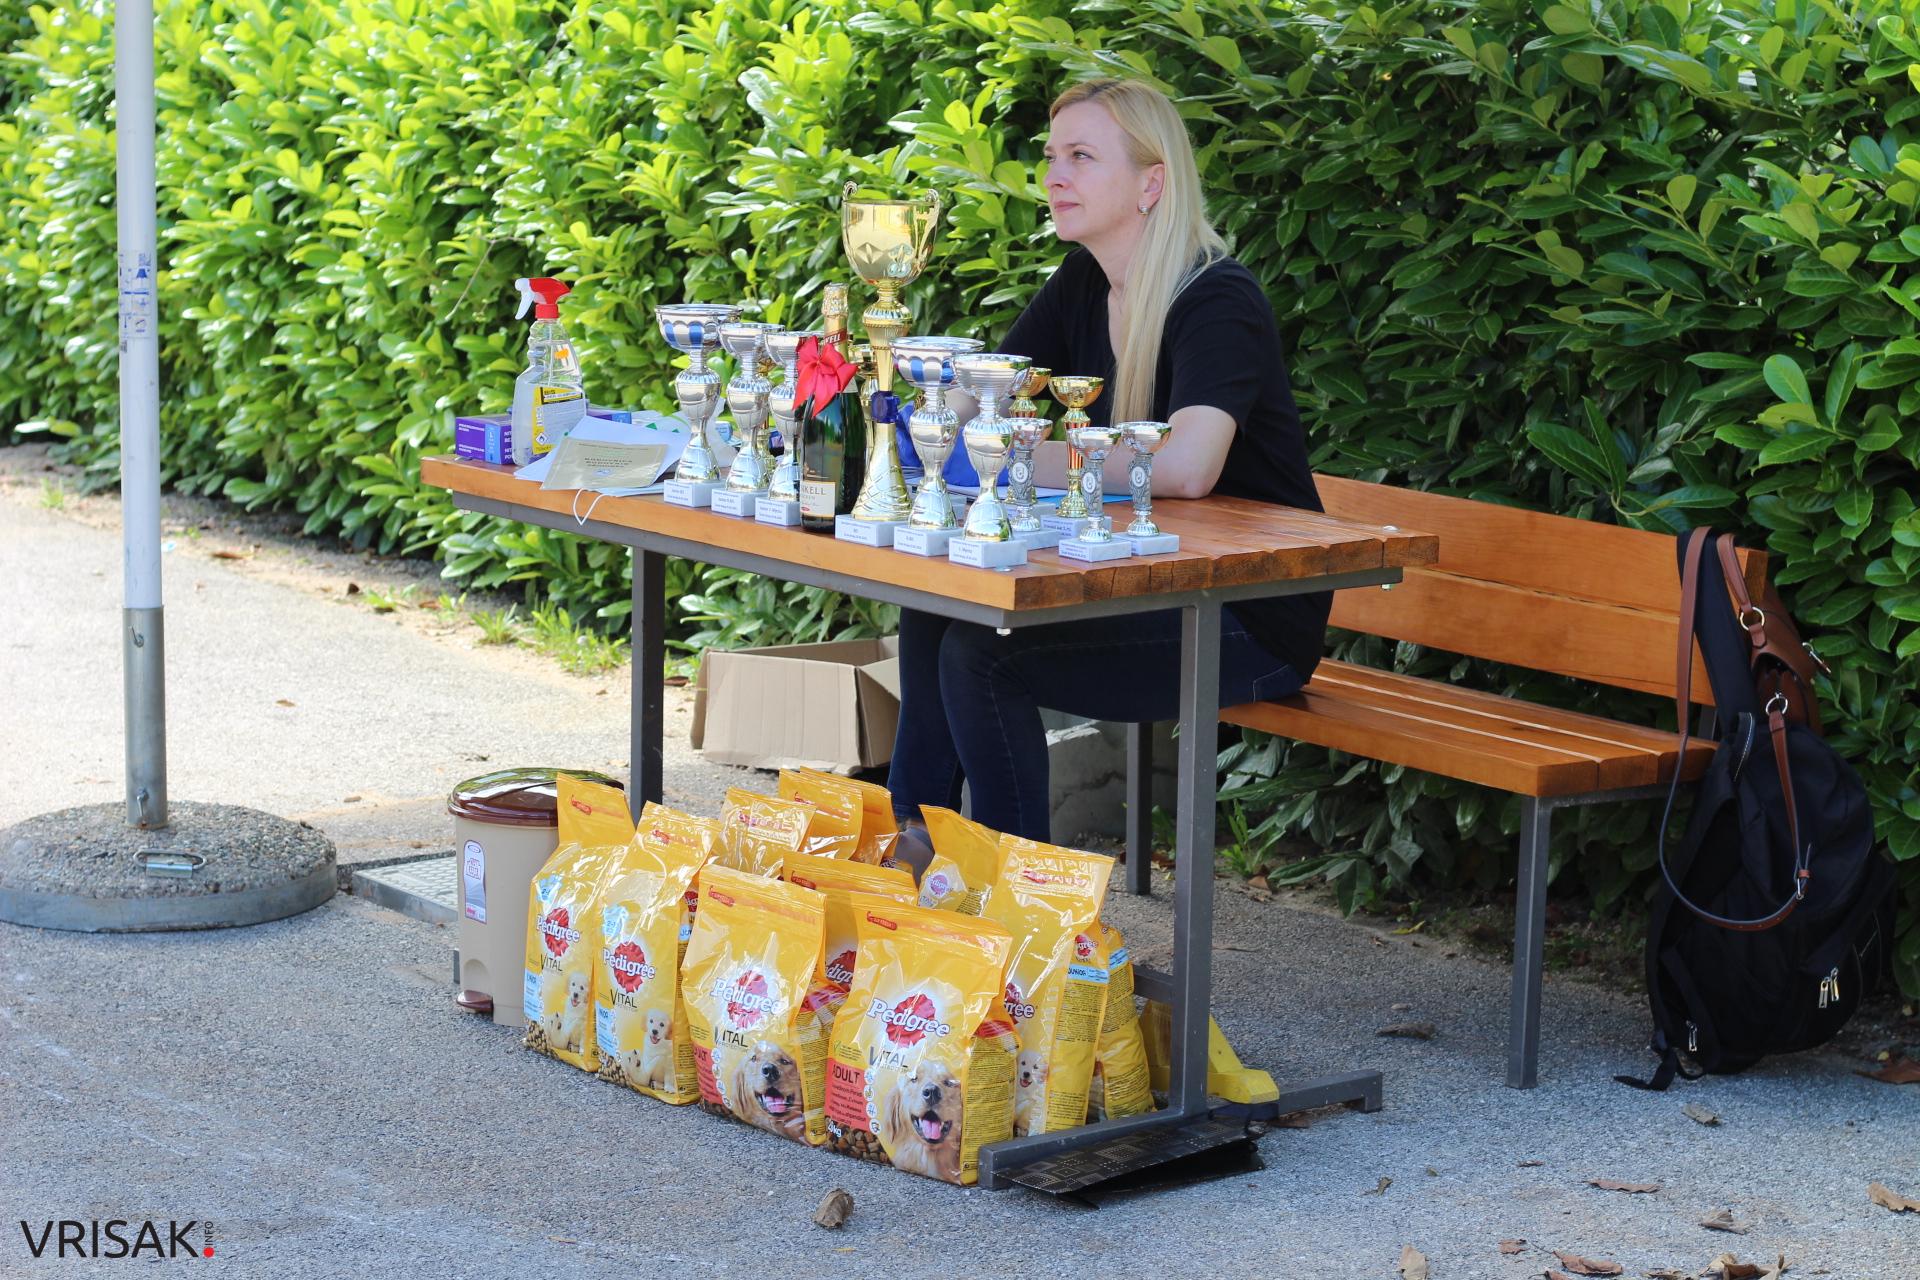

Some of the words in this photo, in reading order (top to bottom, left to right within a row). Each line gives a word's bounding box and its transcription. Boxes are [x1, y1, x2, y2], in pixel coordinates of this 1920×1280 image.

[536, 914, 580, 943] Pedigree
[541, 953, 563, 972] VITAL
[602, 947, 656, 979] Pedigree
[610, 989, 638, 1009] VITAL
[867, 998, 950, 1037] Pedigree
